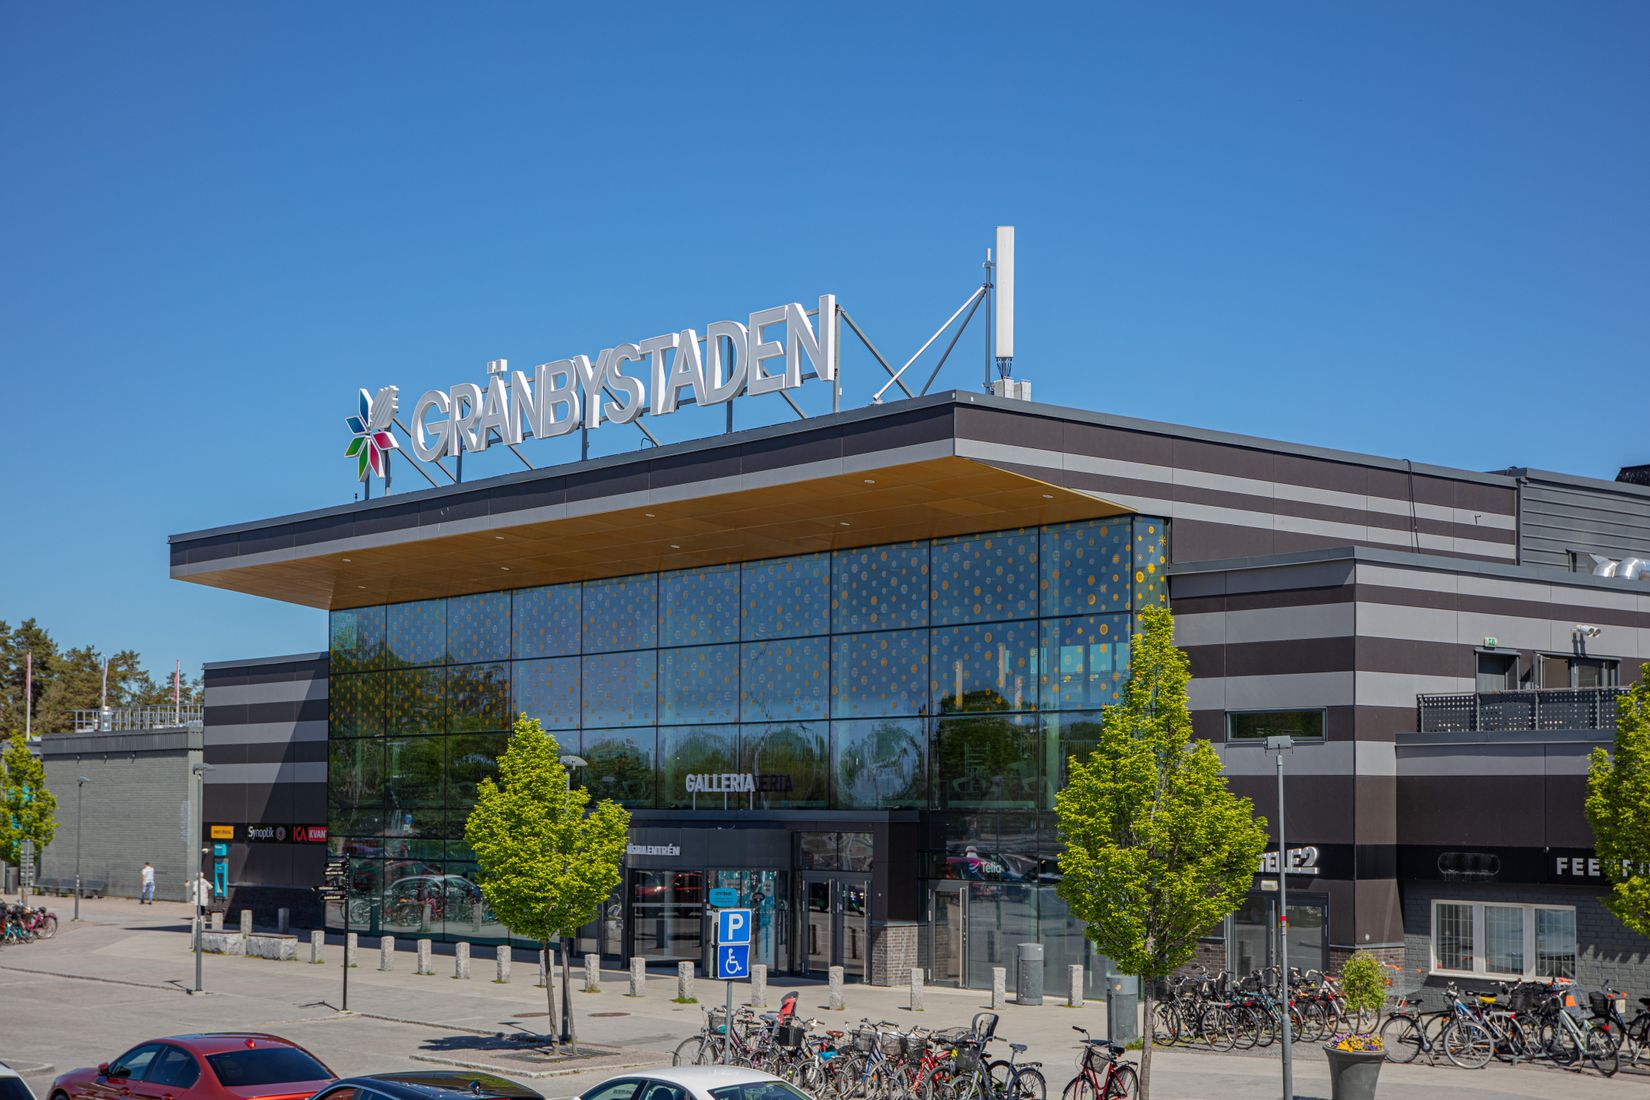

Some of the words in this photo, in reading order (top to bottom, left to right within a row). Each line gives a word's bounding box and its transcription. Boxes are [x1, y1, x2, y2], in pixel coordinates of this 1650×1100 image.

[411, 294, 836, 462] GRÄNBYSTADEN
[685, 773, 756, 793] GALLERIA
[248, 826, 274, 840] Synoptik
[293, 826, 307, 842] ICA
[647, 843, 680, 856] ENTRÉN
[728, 913, 744, 940] P
